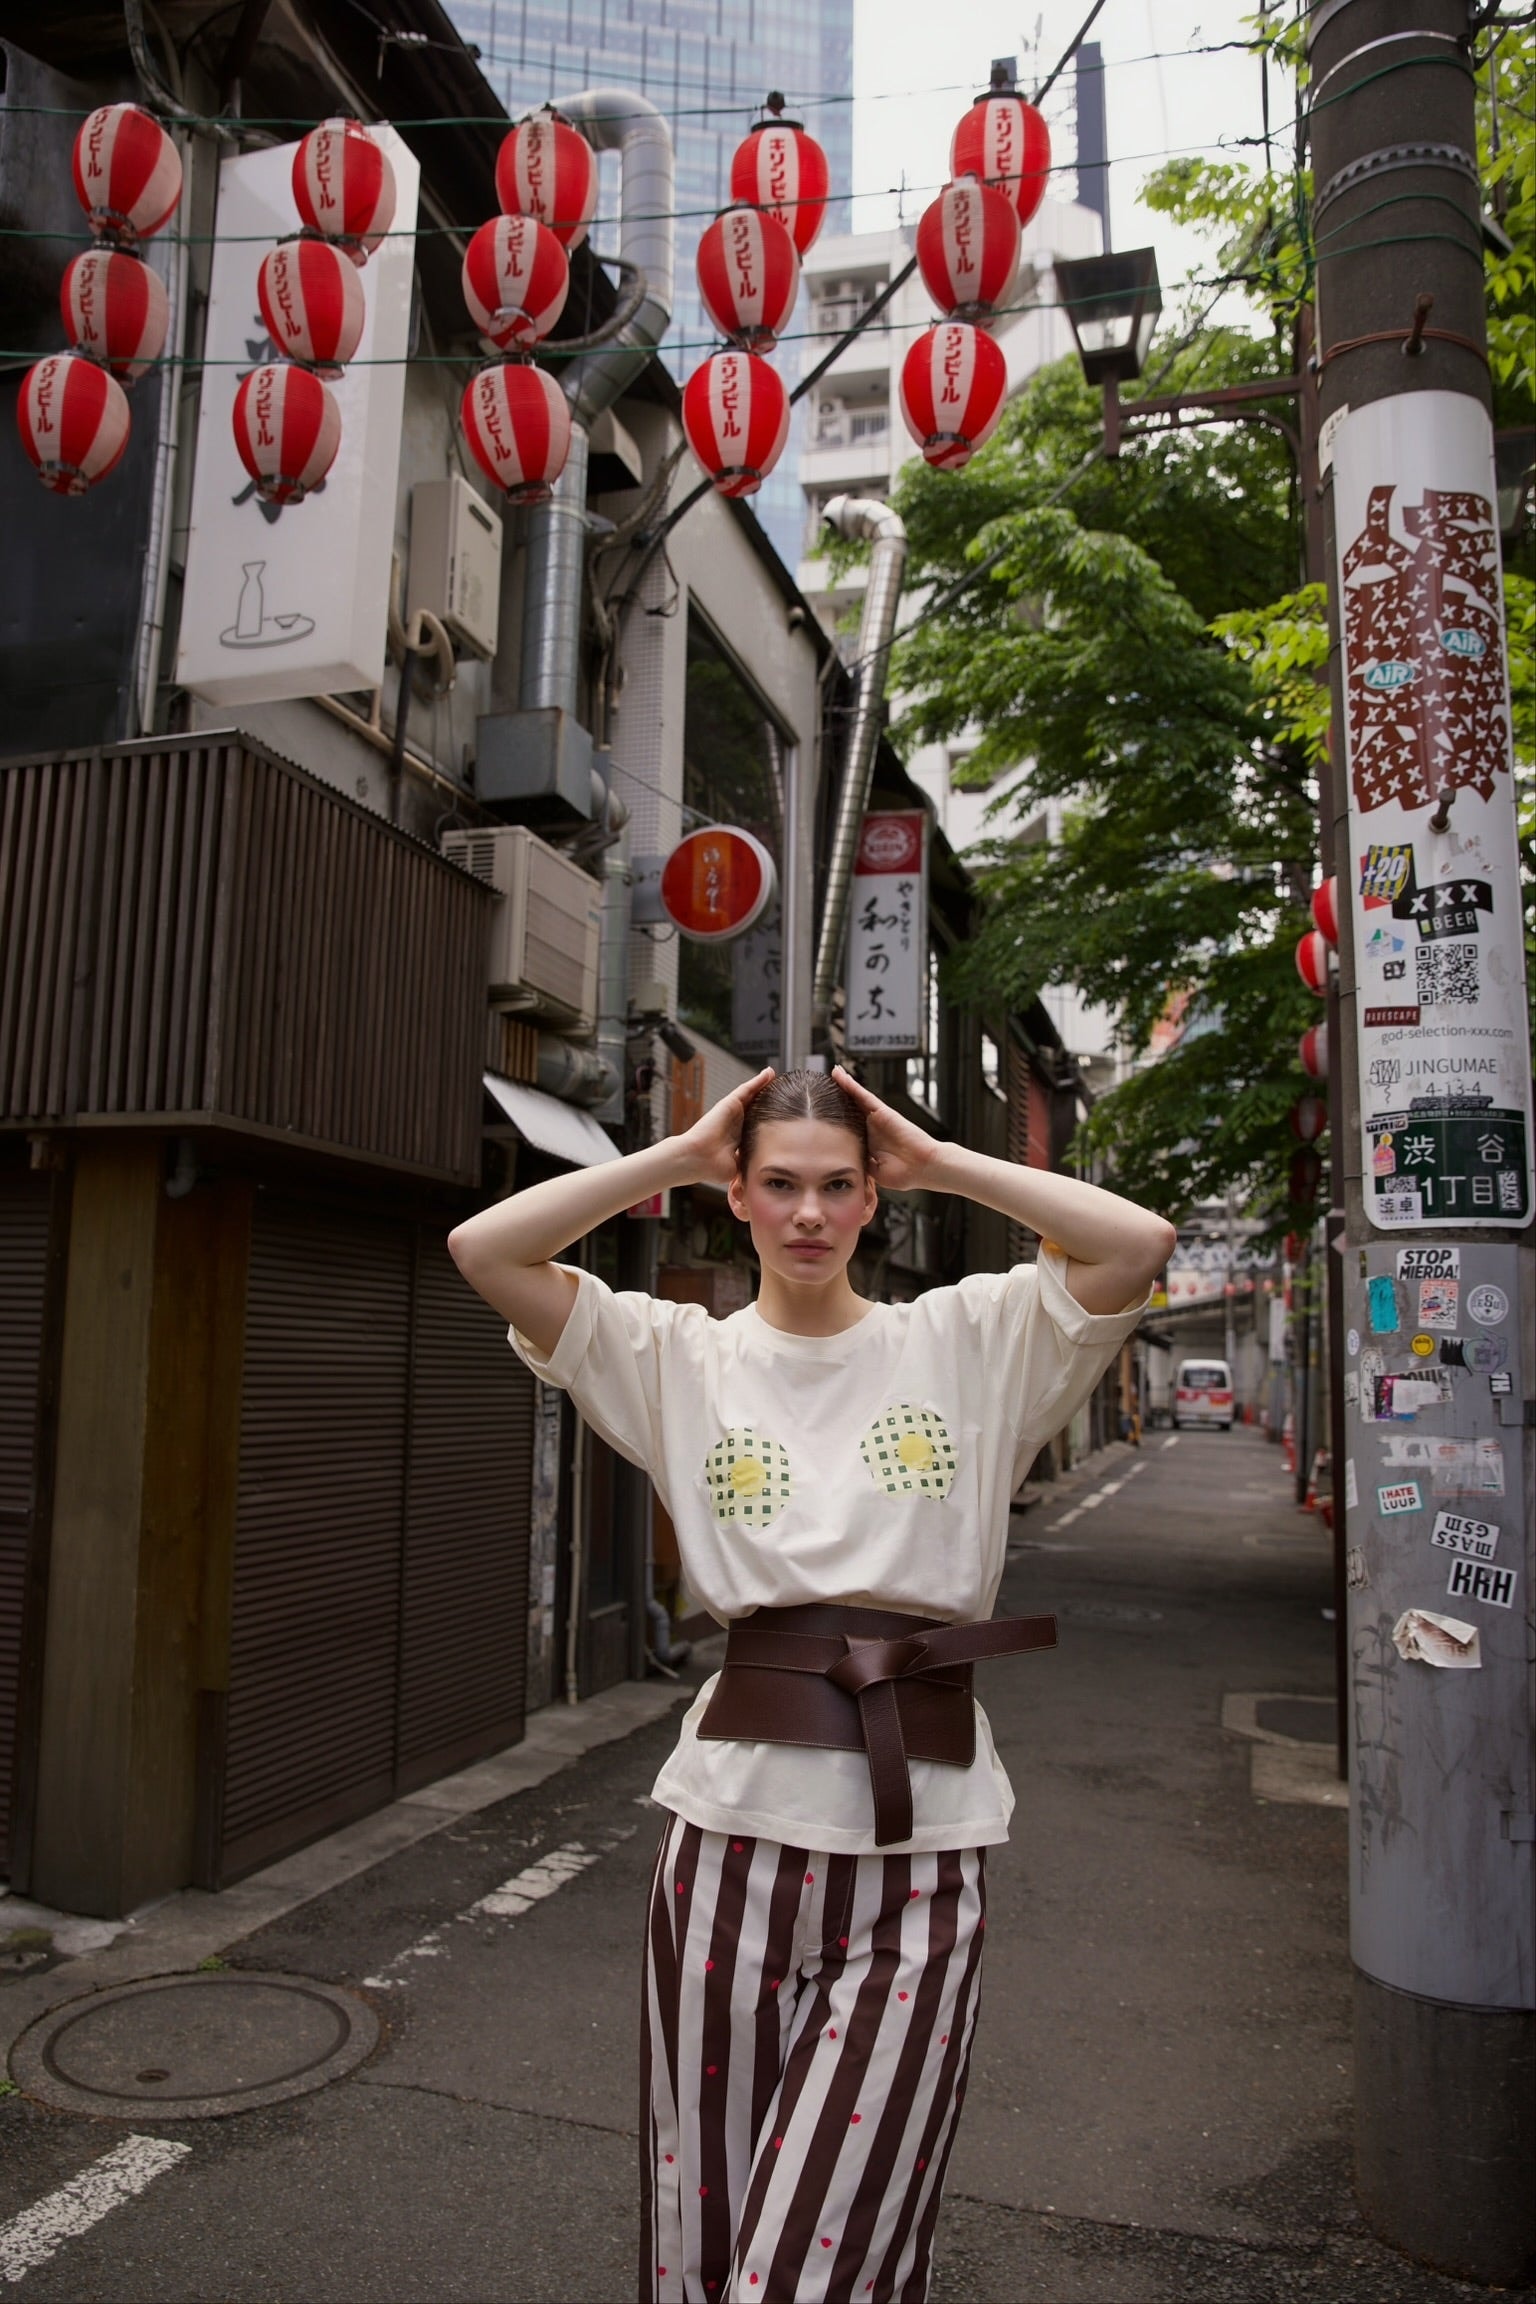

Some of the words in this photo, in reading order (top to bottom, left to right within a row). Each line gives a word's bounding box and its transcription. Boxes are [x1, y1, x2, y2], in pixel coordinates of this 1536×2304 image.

[316, 130, 336, 210] キリンビール
[953, 189, 974, 275] キリンビール
[732, 215, 757, 299] キリンビール
[79, 258, 98, 342] キリンビール
[274, 251, 301, 338] キリンビール
[941, 326, 964, 403] キリンビール
[257, 368, 274, 446] キリンビール
[722, 357, 741, 438] キリンビール
[480, 375, 511, 461] キリンビール
[1432, 912, 1476, 932] BEER
[1381, 1024, 1513, 1045] god-selection-xxx.com
[1405, 1058, 1497, 1076] JINGUMAE
[1425, 1081, 1481, 1097] 4-13-4
[1403, 1133, 1506, 1166] 渋谷
[1421, 1175, 1493, 1206] 1丁目
[1399, 1265, 1459, 1280] MIERDA!
[1404, 1249, 1452, 1266] STOP
[1383, 1497, 1416, 1511] LUUP
[1386, 1486, 1415, 1499] HATE
